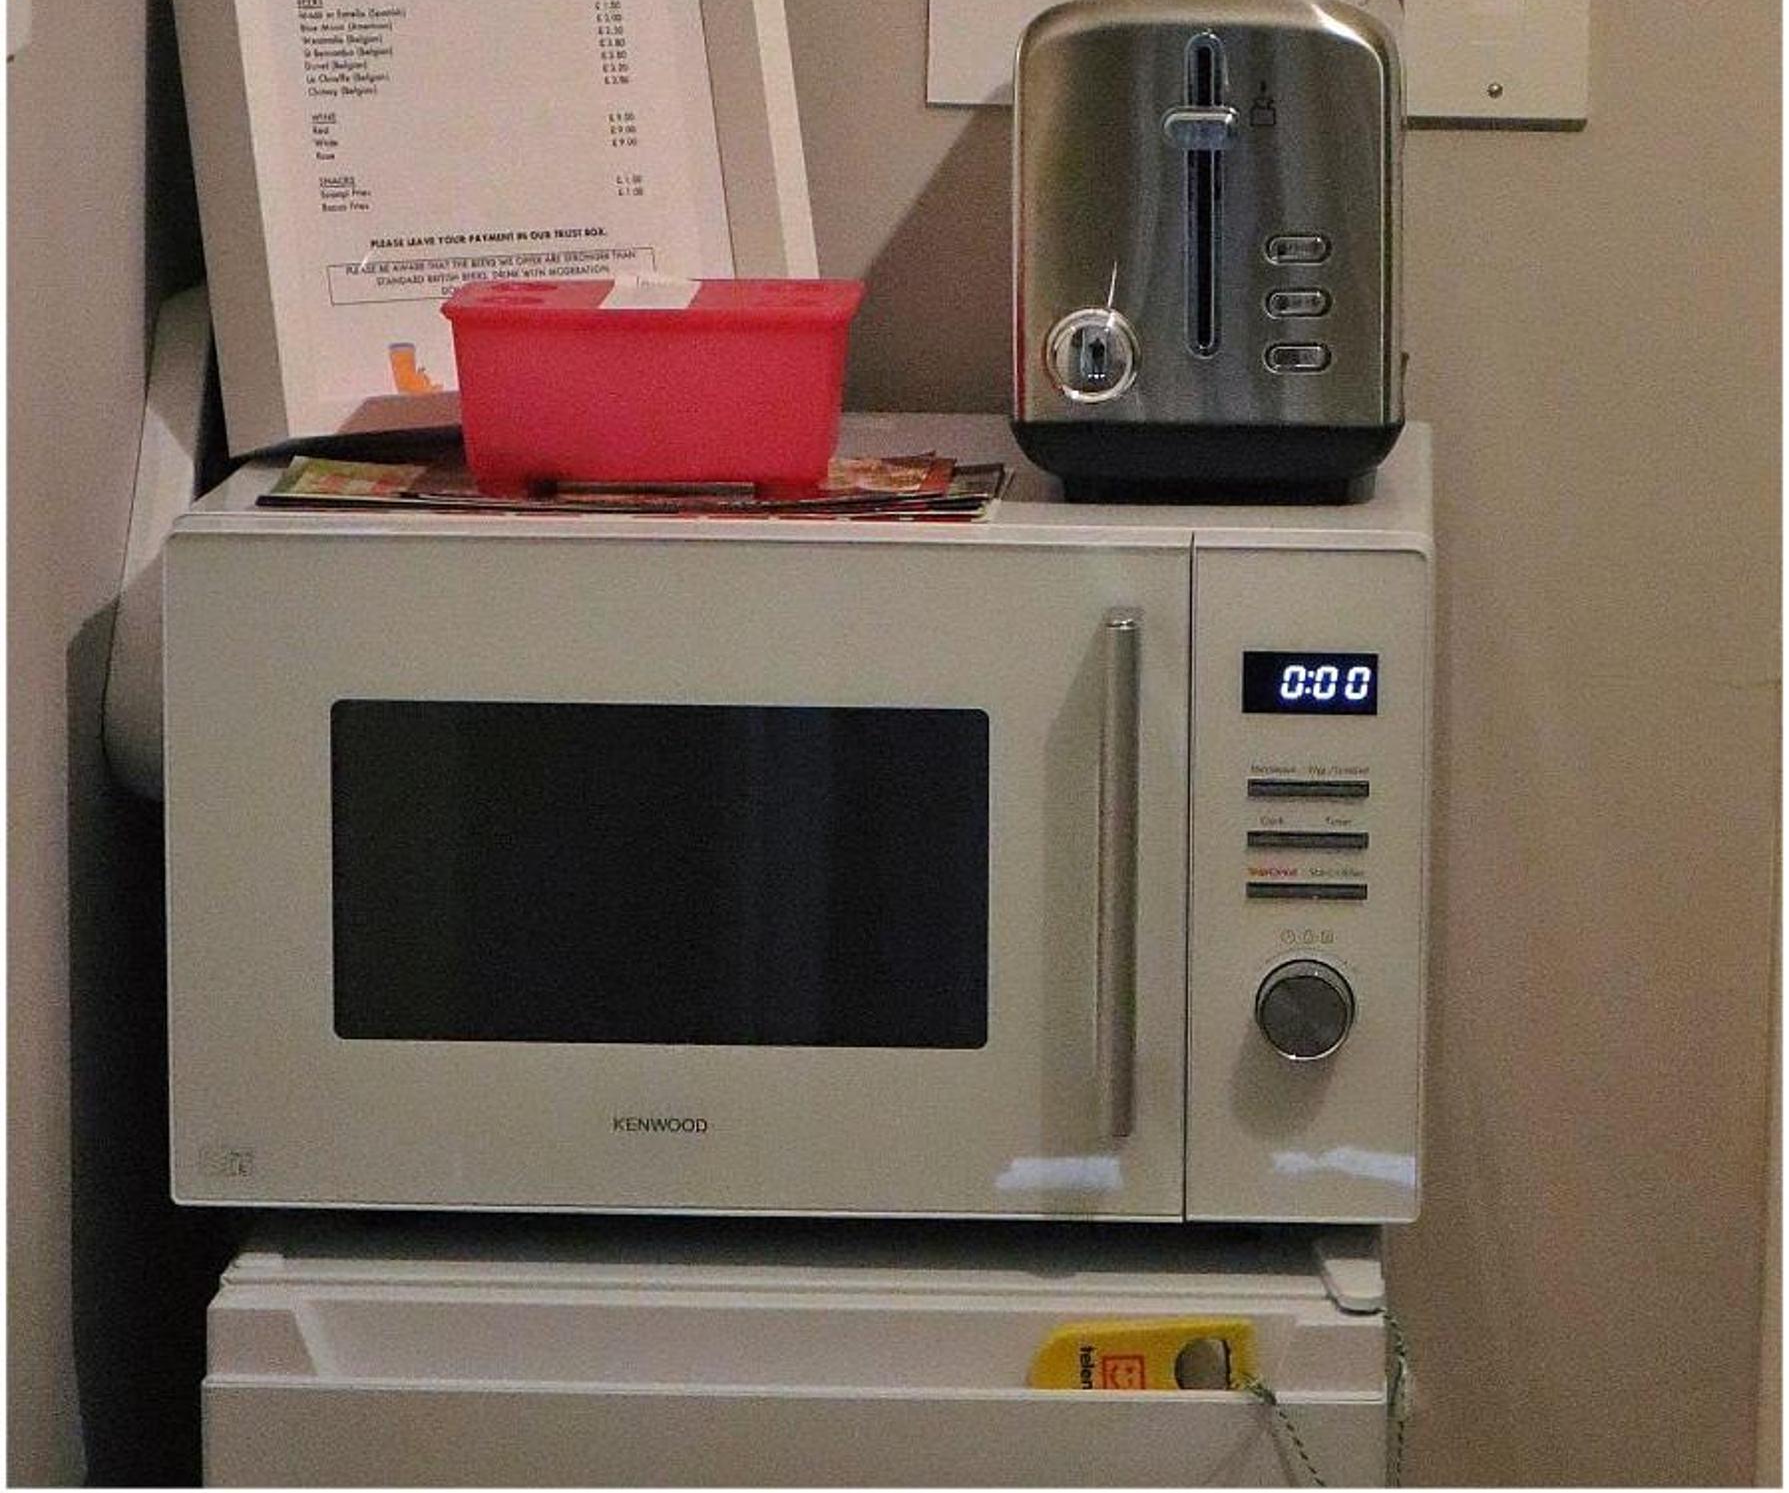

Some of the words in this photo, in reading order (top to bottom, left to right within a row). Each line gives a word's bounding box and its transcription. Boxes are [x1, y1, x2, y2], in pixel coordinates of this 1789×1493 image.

[370, 238, 405, 249] PLEASE
[408, 236, 436, 247] LEAVE
[438, 234, 467, 245] YOUR
[469, 231, 514, 244] PAYMENT
[531, 230, 551, 240] OUR
[554, 228, 583, 239] TRUST
[1280, 664, 1372, 701] 0:00
[613, 1116, 708, 1133] KENWOOD
